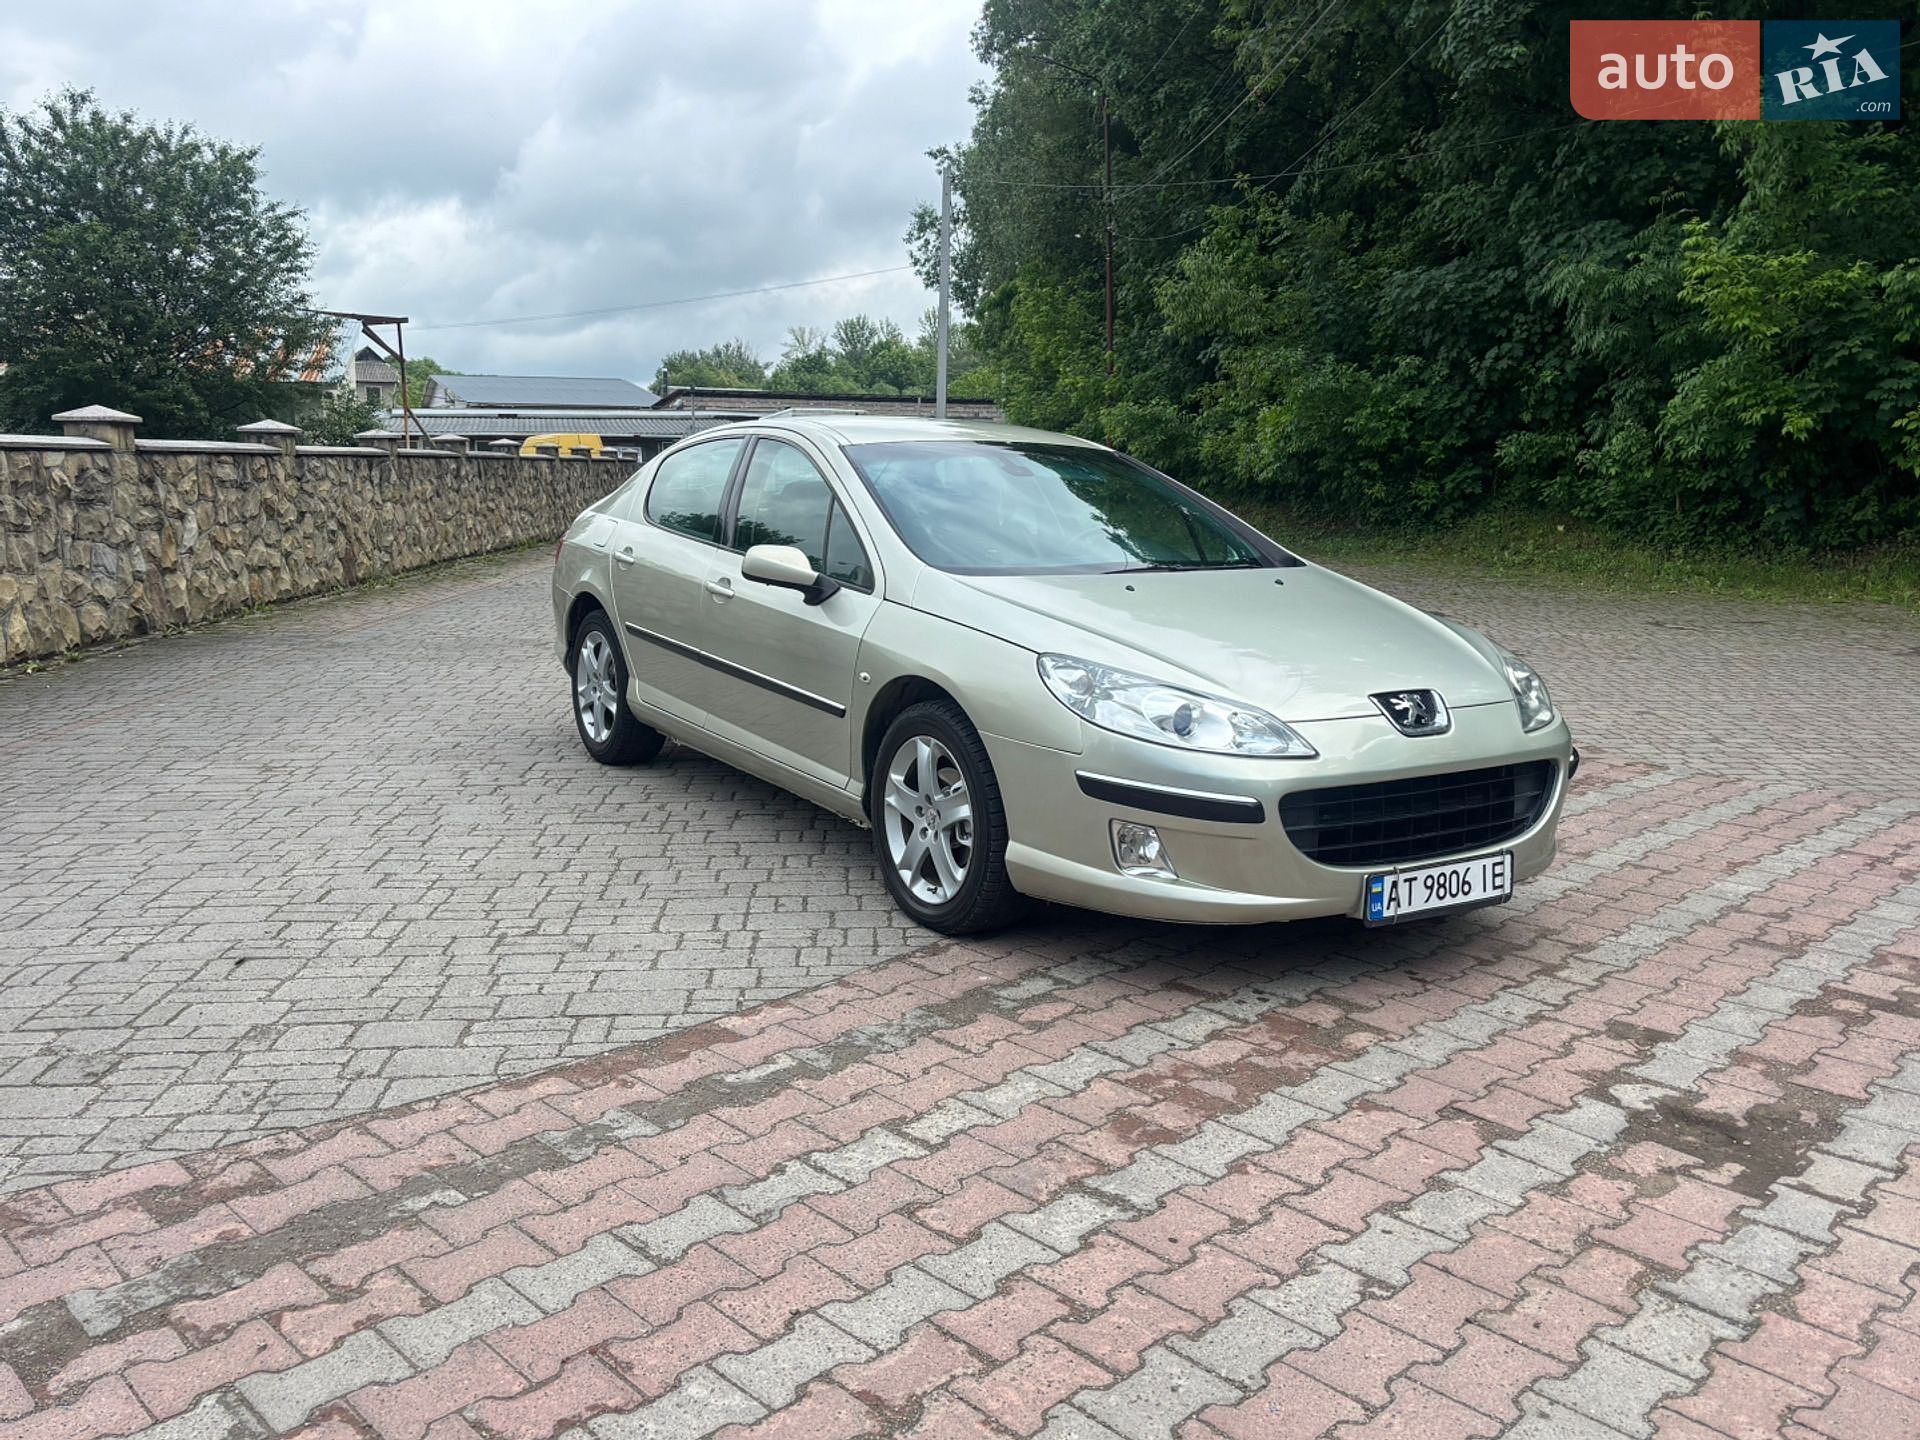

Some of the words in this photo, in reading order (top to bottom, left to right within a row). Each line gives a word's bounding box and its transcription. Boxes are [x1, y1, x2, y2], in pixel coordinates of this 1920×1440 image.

[1386, 876, 1418, 910] AT
[1424, 867, 1472, 904] 9806
[1482, 860, 1505, 893] IE
[1371, 902, 1383, 912] UA
